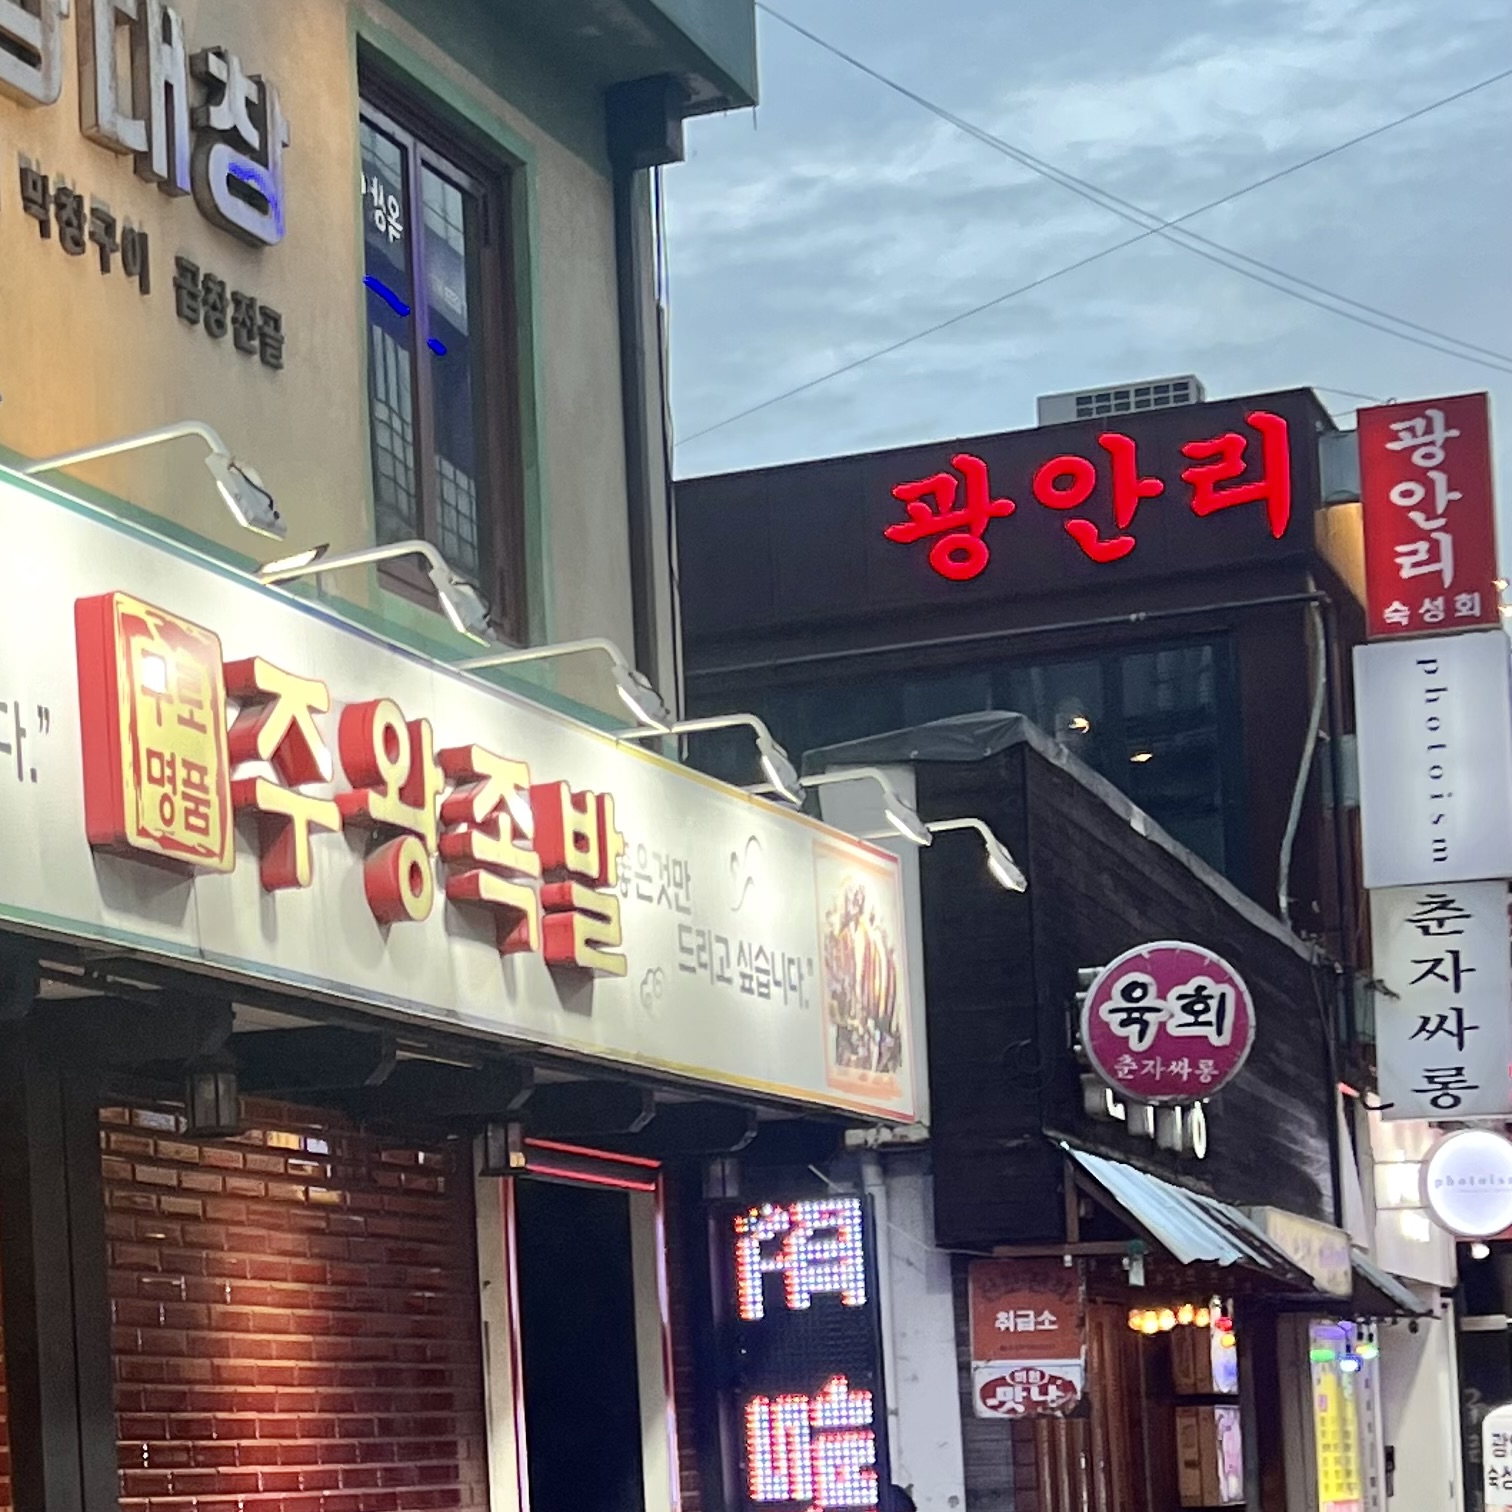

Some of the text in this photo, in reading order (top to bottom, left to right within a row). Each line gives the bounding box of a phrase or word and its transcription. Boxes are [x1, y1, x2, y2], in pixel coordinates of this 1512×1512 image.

[19, 166, 151, 296] 막창구이
[173, 255, 285, 370] 곱창전골
[883, 411, 1291, 581] 광안리
[1385, 408, 1463, 589] 광안리
[1383, 591, 1482, 627] 숙성회
[145, 746, 212, 838] 명품
[224, 656, 628, 978] 주왕족발
[1415, 658, 1454, 863] photoism
[677, 922, 734, 986] 드리고
[1106, 978, 1229, 1045] 육회
[1404, 892, 1481, 1110] 춘자싸롱
[1114, 1053, 1221, 1084] 춘자싸롱
[994, 1309, 1060, 1333] 취급소
